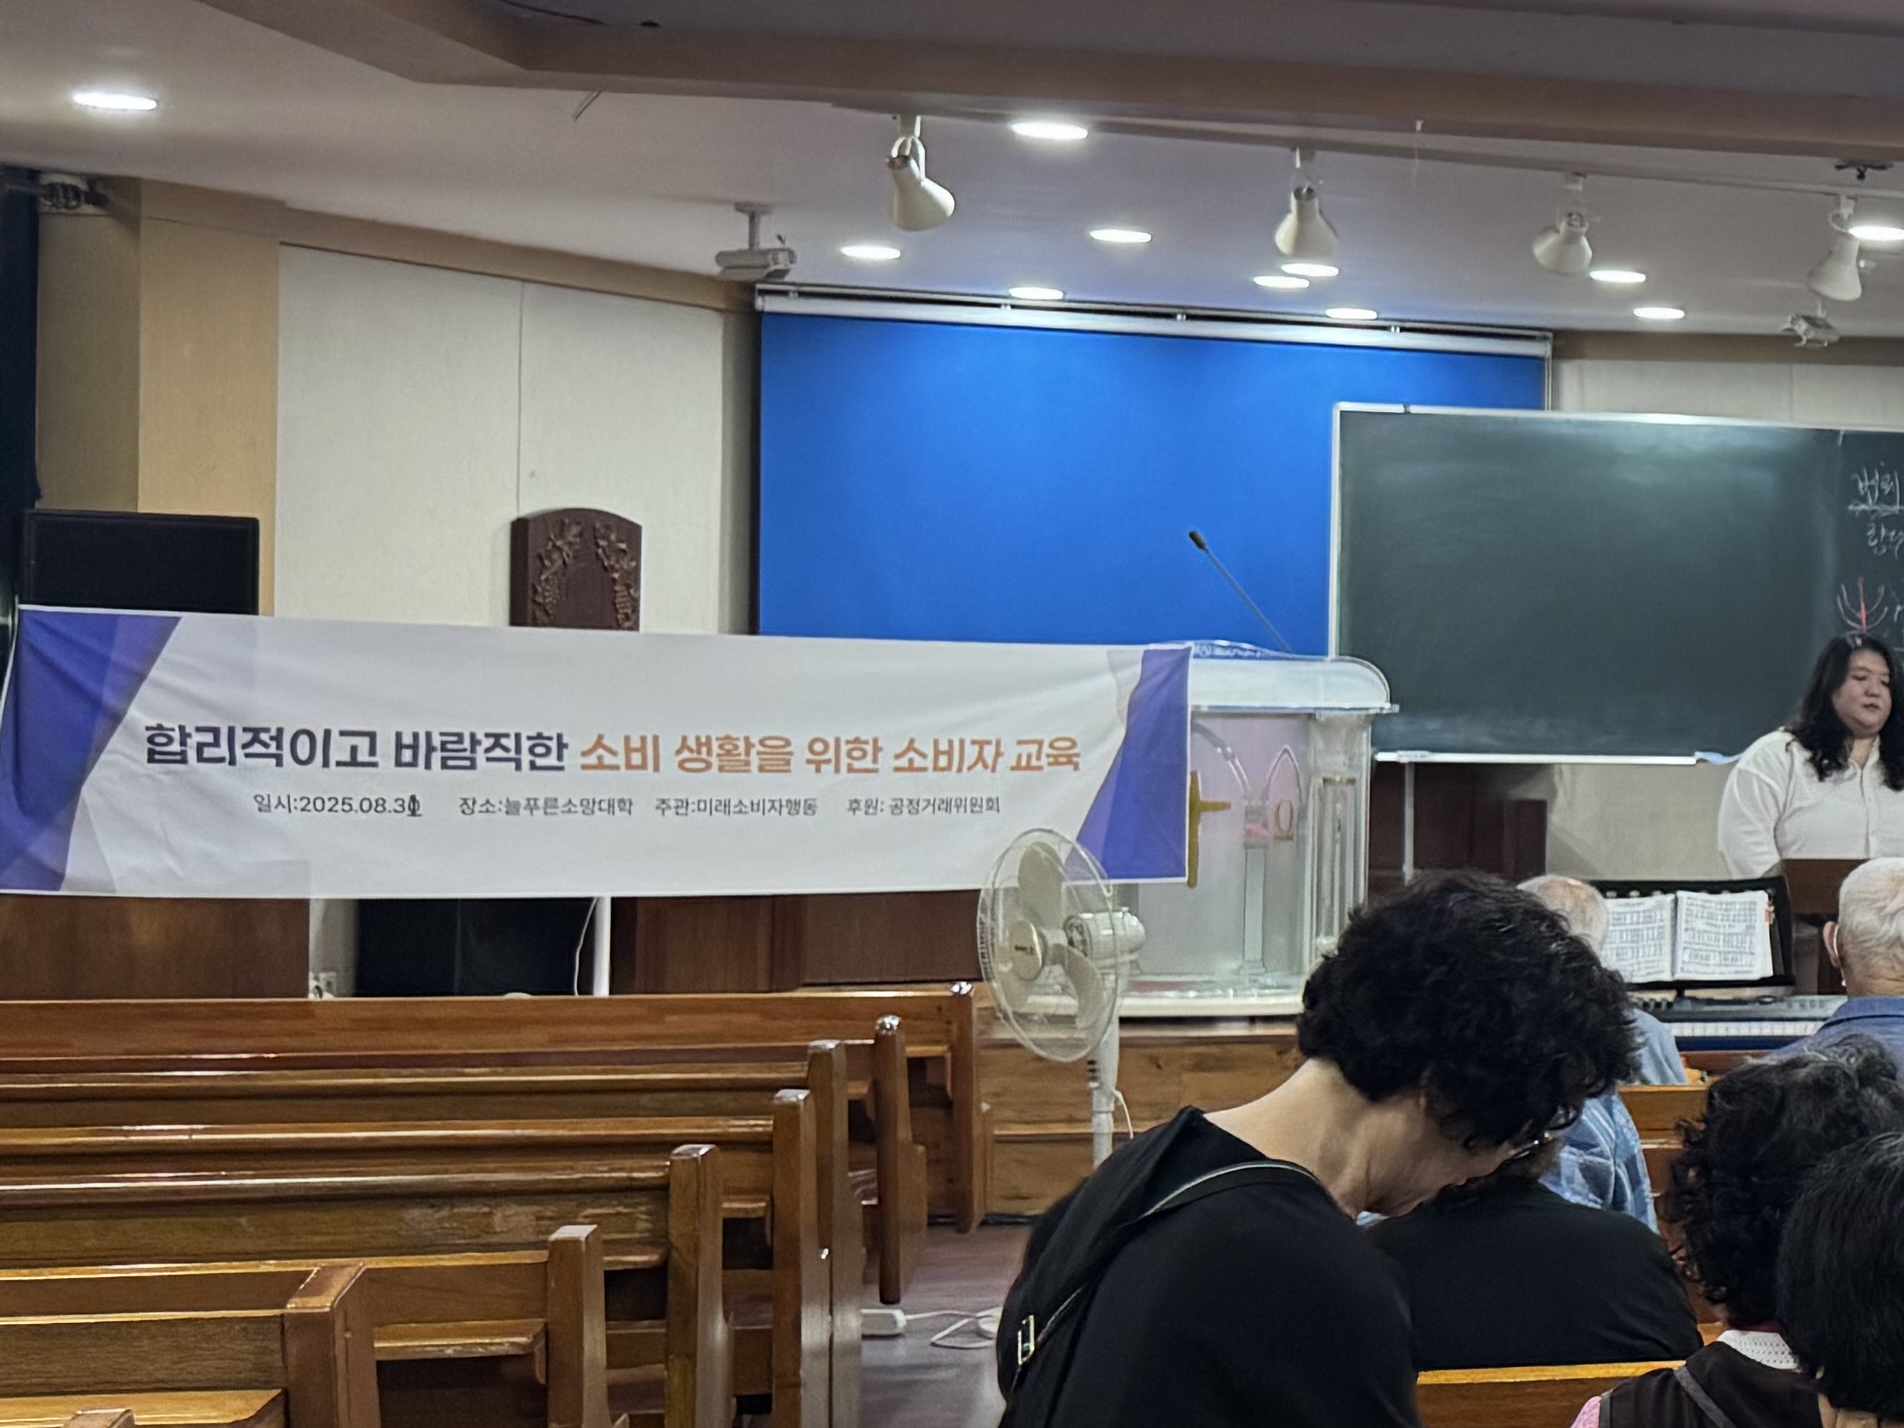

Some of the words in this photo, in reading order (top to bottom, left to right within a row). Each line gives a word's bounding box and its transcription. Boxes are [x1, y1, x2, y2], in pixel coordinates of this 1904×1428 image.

[145, 723, 379, 769] 합리적이고
[394, 730, 569, 772] 바람직한
[580, 733, 661, 773] 소비
[675, 734, 795, 774] 생활을
[805, 736, 884, 775] 위한
[892, 736, 1004, 775] 소비자
[1009, 736, 1082, 773] 교육
[847, 797, 885, 817] 후원:
